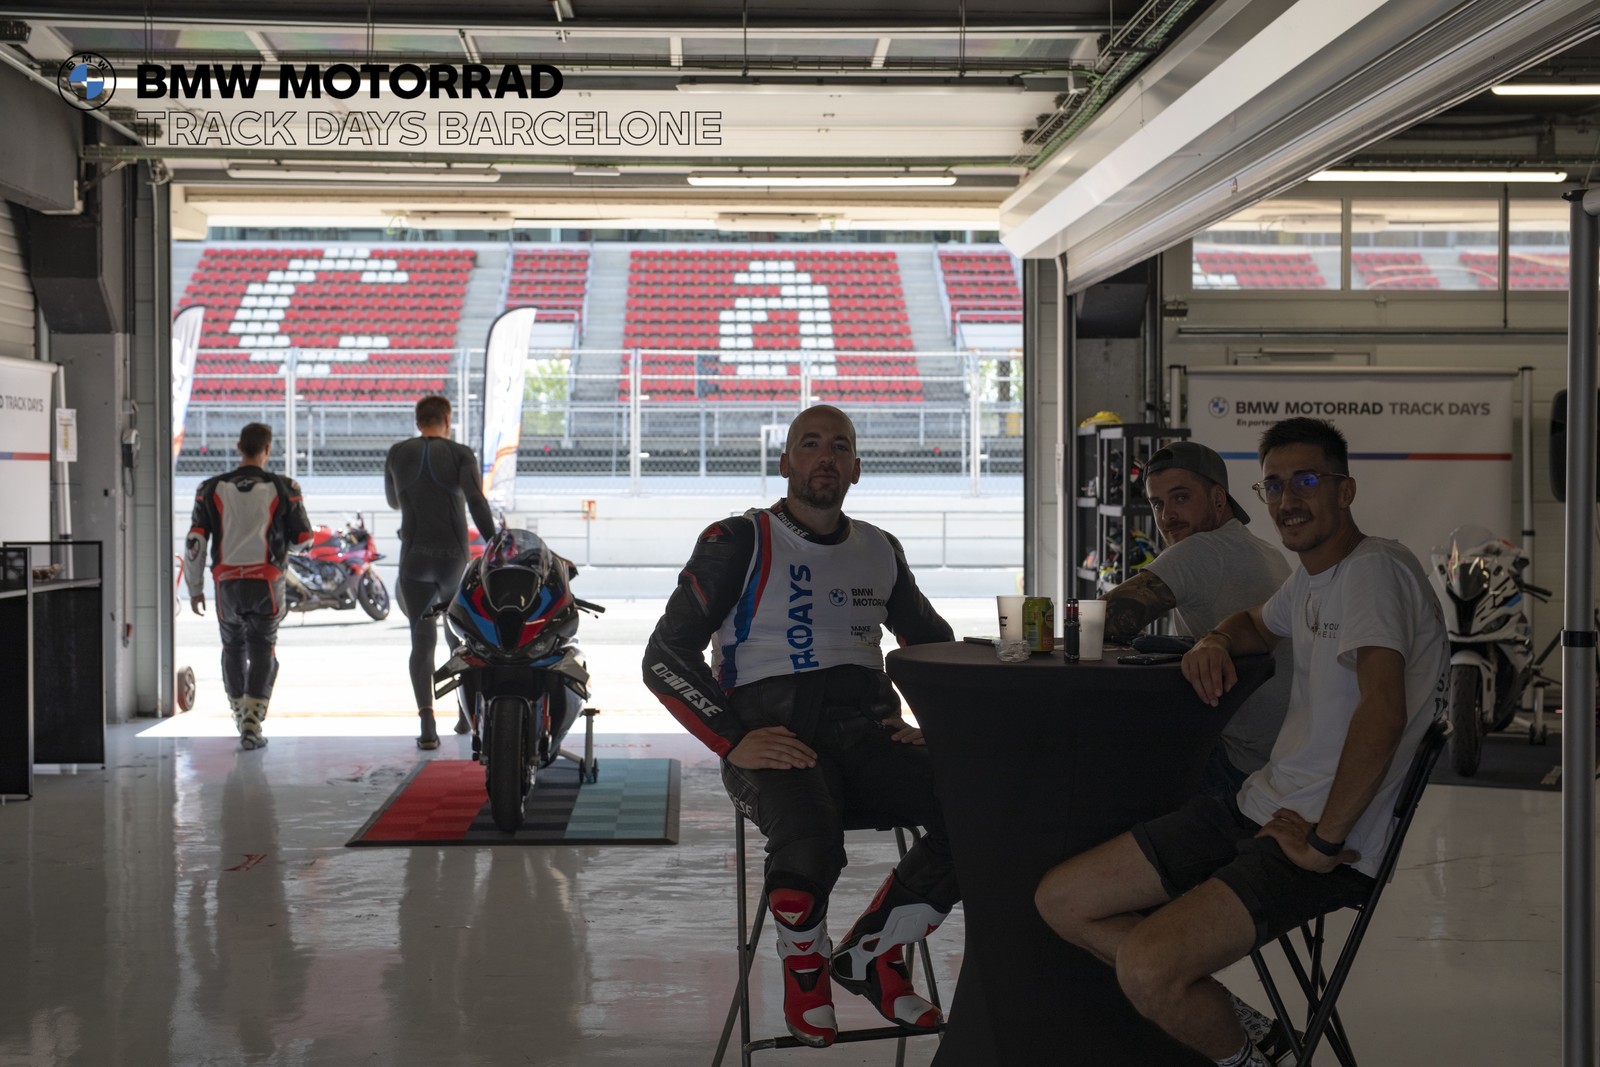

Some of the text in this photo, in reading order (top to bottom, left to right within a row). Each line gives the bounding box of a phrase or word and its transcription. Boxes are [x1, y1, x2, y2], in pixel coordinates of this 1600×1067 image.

[5, 395, 27, 410] TRACK
[27, 398, 44, 413] DAYS
[1235, 401, 1491, 415] BMW MOTORRAD TRACK DAYS
[851, 588, 873, 596] BMW
[1323, 622, 1340, 631] YOU
